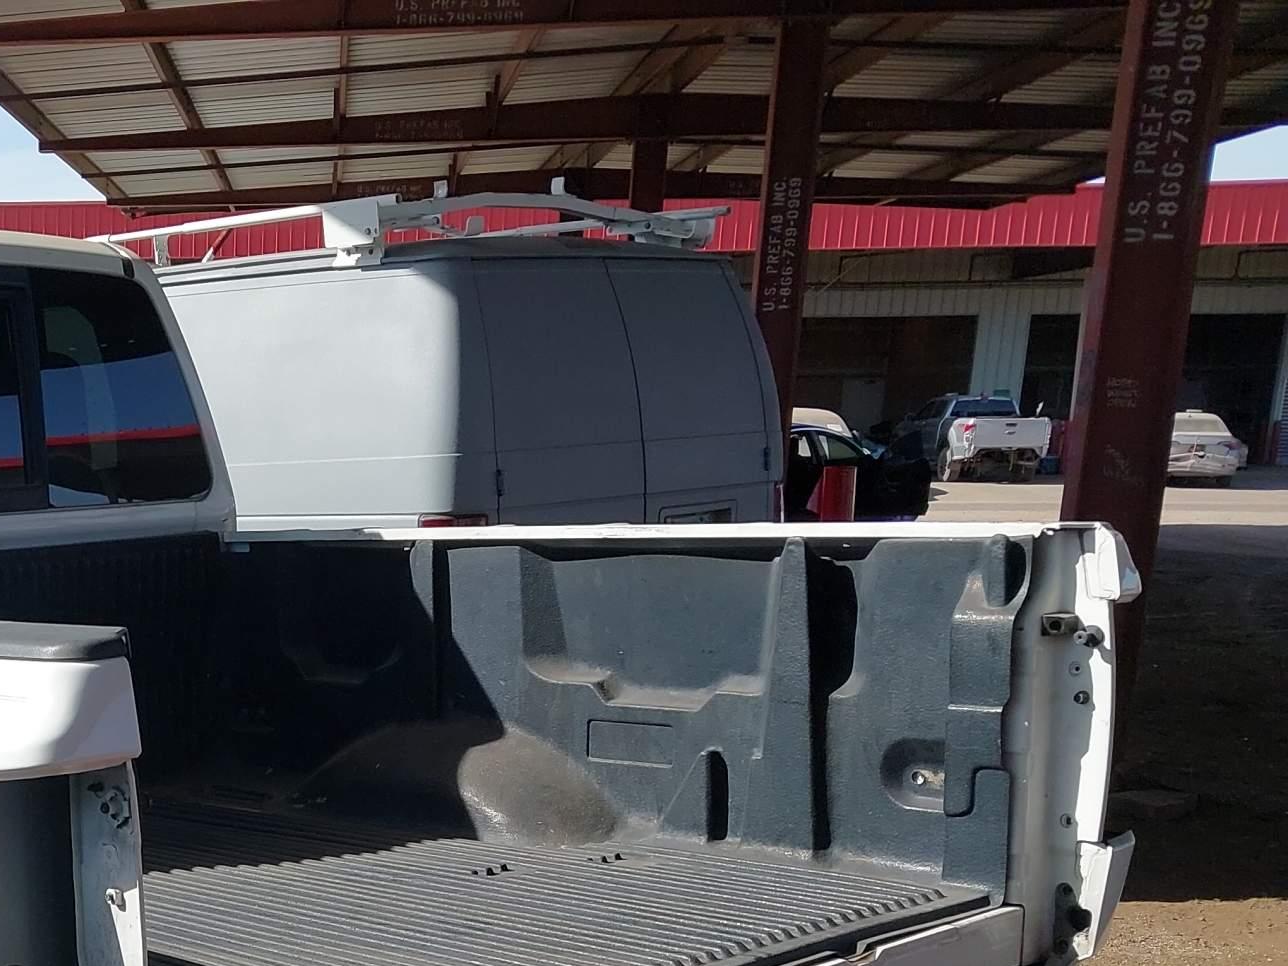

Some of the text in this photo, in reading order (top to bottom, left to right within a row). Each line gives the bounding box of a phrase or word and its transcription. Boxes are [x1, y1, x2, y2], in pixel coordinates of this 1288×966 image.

[1134, 64, 1170, 174] PREFAB
[763, 176, 787, 312] U.S. PREFAB INC.
[778, 177, 802, 310] 1-866-799-0969
[1123, 192, 1153, 243] U.S.
